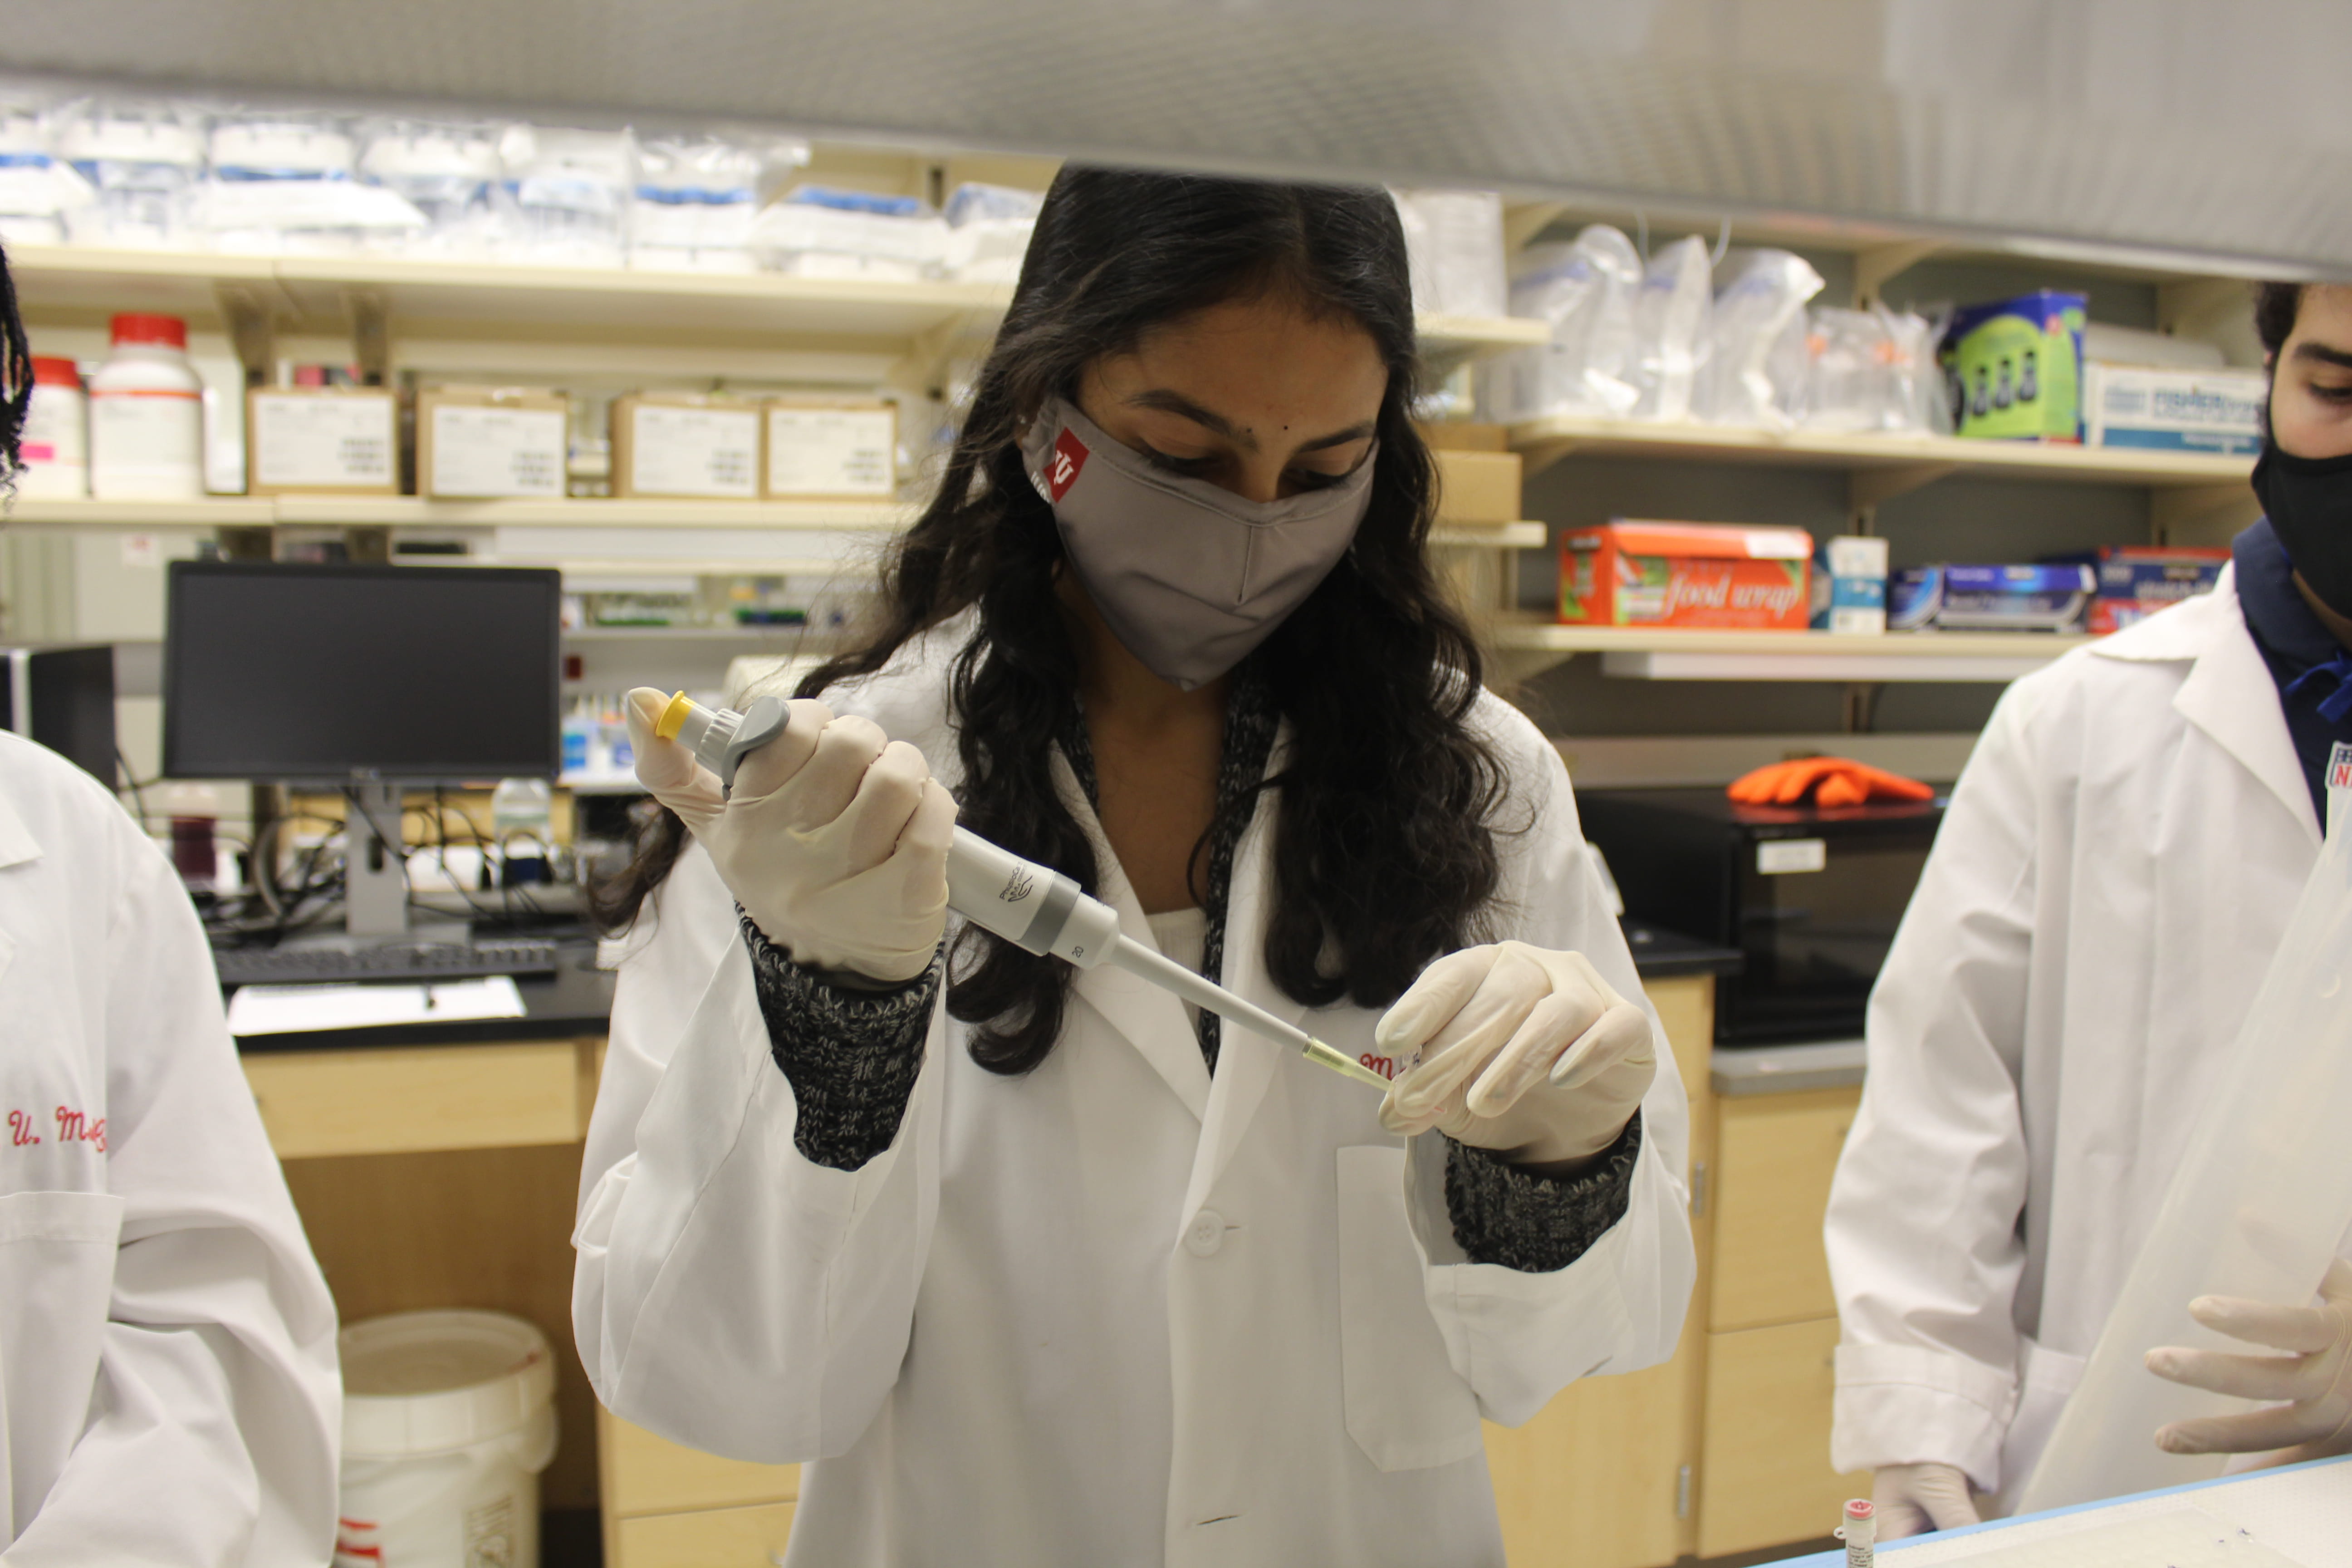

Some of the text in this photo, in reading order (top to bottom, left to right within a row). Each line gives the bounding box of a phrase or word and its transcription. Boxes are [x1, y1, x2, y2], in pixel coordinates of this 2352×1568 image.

[1664, 572, 1798, 617] food wrap
[1072, 946, 1084, 958] 20
